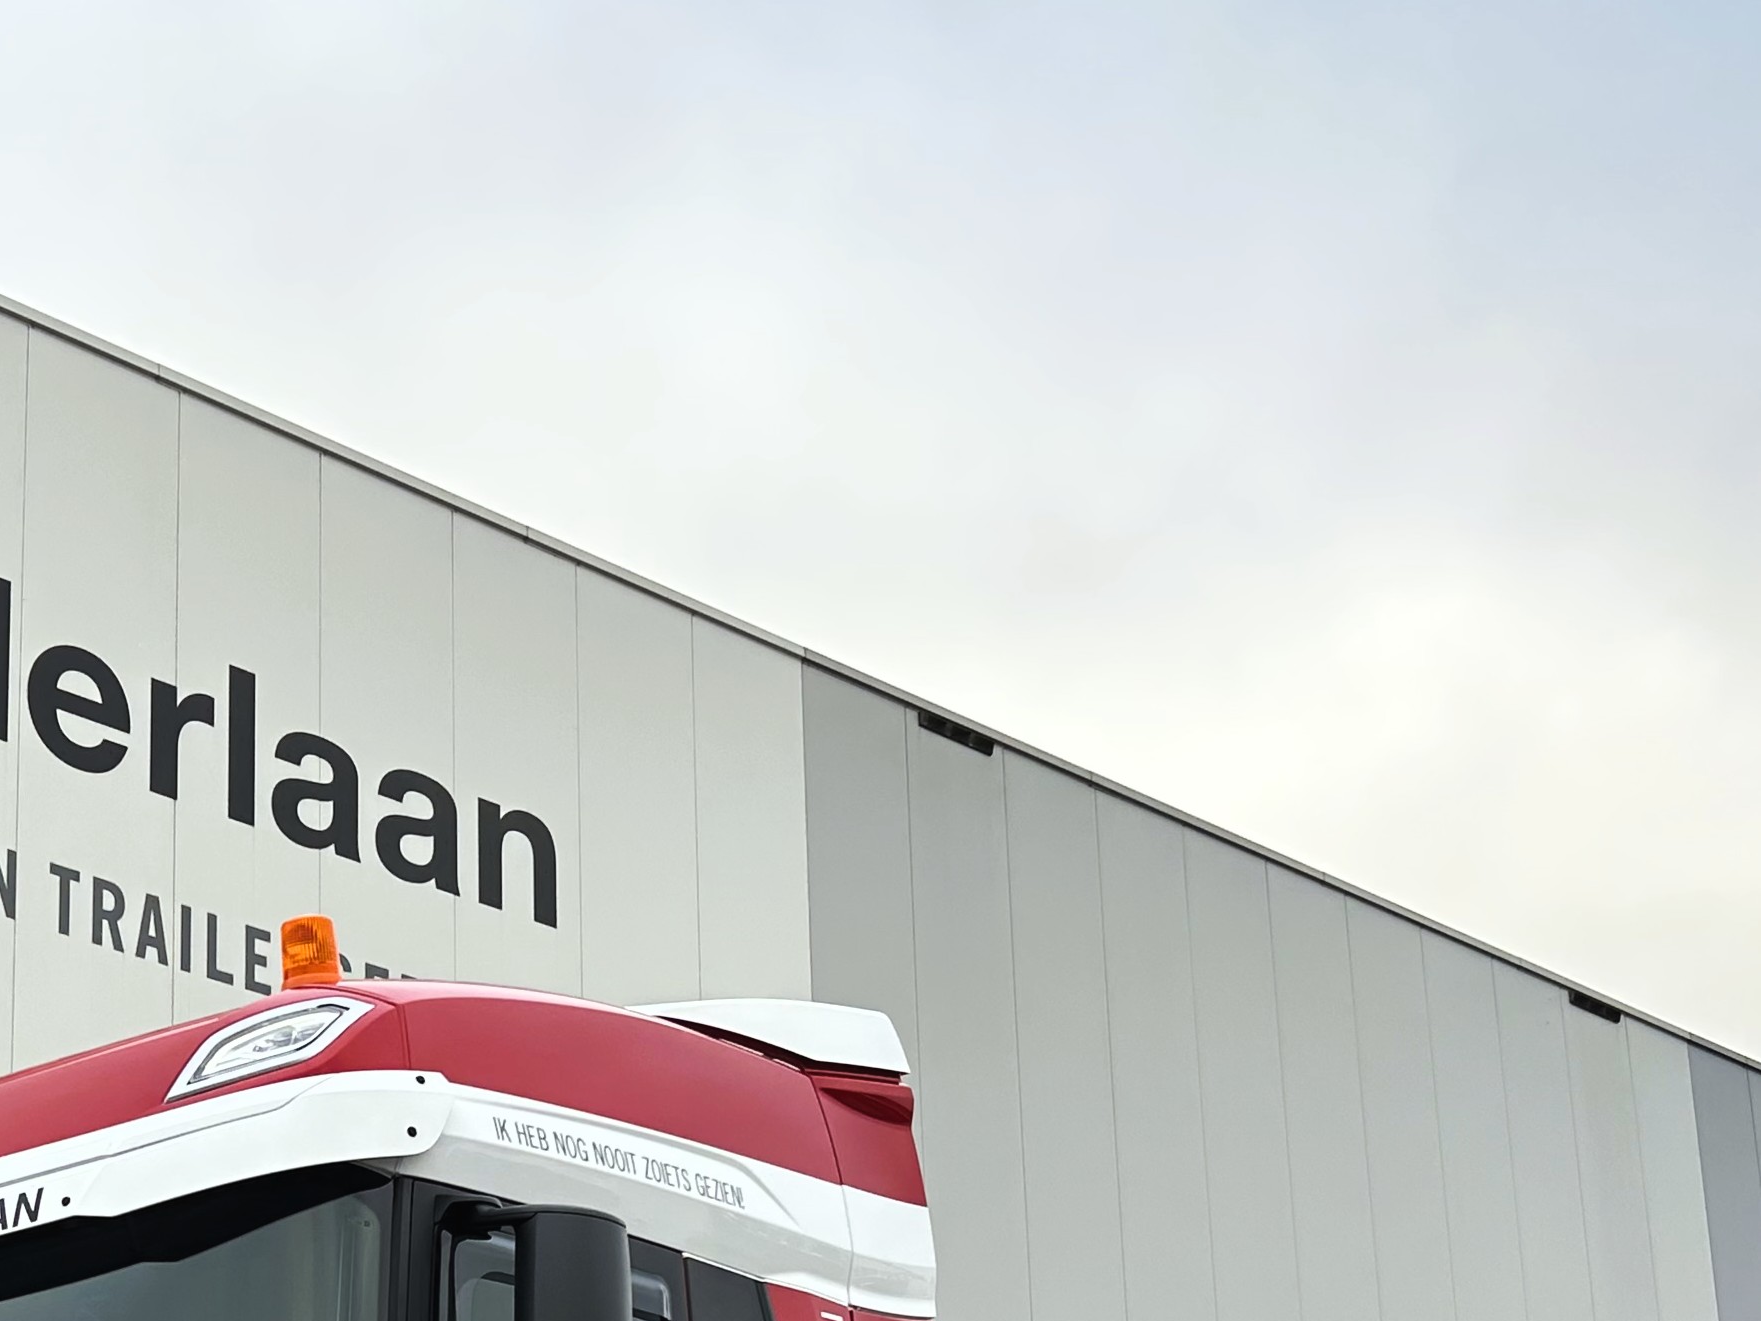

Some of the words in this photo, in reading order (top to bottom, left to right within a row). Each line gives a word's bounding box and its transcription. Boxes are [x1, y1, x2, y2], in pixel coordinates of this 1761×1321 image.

[49, 862, 273, 997] TRAILE
[492, 1116, 512, 1143] IK
[514, 1121, 550, 1152] HEB
[552, 1131, 589, 1162] NOG
[591, 1141, 637, 1175] NOOIT
[641, 1156, 692, 1192] ZOIETS
[694, 1173, 746, 1210] GEZIEN!
